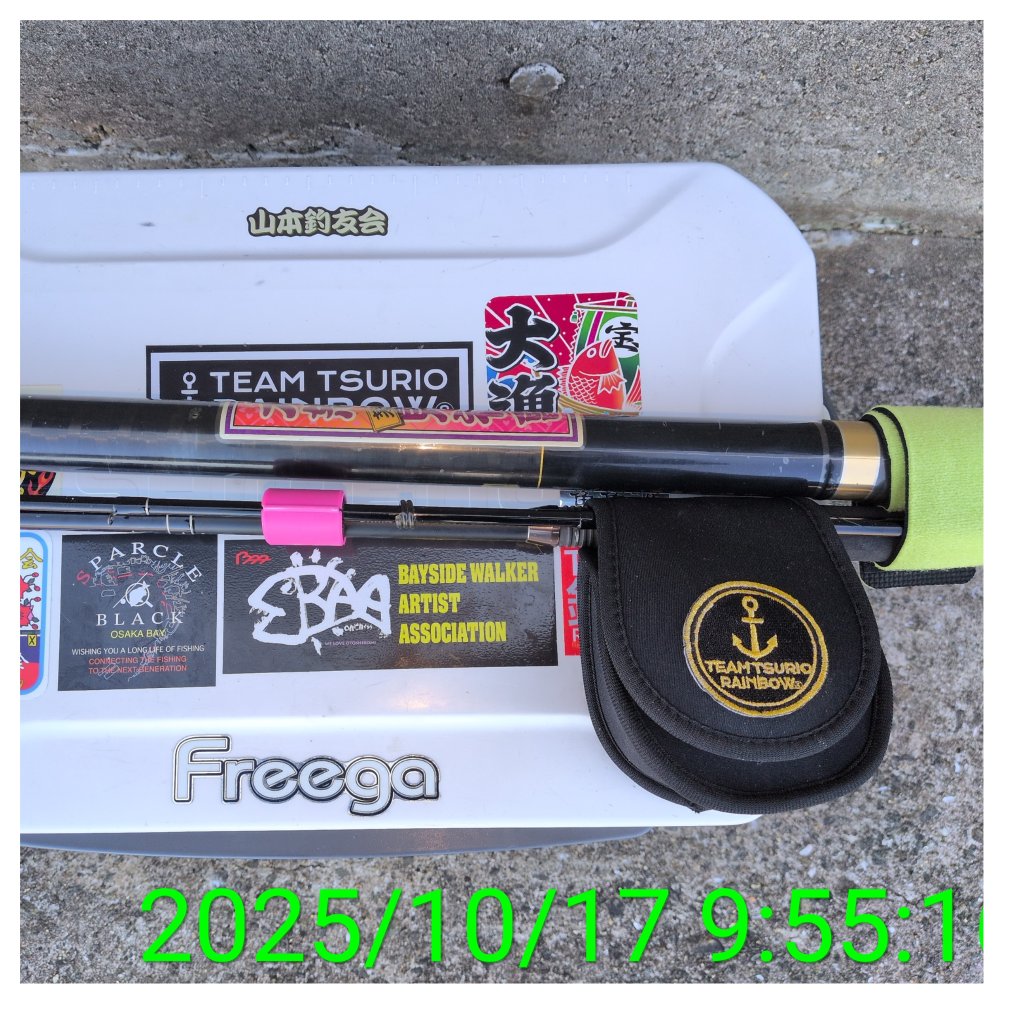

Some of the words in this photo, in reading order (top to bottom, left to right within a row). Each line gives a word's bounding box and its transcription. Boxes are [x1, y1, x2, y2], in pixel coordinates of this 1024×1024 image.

[249, 207, 388, 236] 山本釣友会
[604, 321, 639, 352] 宝
[209, 371, 305, 394] TEAM
[319, 368, 448, 392] TSURIO
[398, 563, 467, 585] BAYSIDE
[469, 561, 539, 584] WALKER
[398, 592, 460, 615] ARTIST
[95, 611, 184, 627] BLACK
[110, 629, 144, 639] OSAKA
[146, 628, 166, 638] BAY
[398, 621, 507, 645] ASSOCIATION
[72, 648, 102, 656] WISHING
[103, 647, 119, 655] YOU
[127, 646, 148, 654] LONG
[165, 645, 174, 653] OF
[176, 644, 205, 653] FISHING
[88, 657, 138, 665] CONNECTING
[173, 734, 441, 817] Freega
